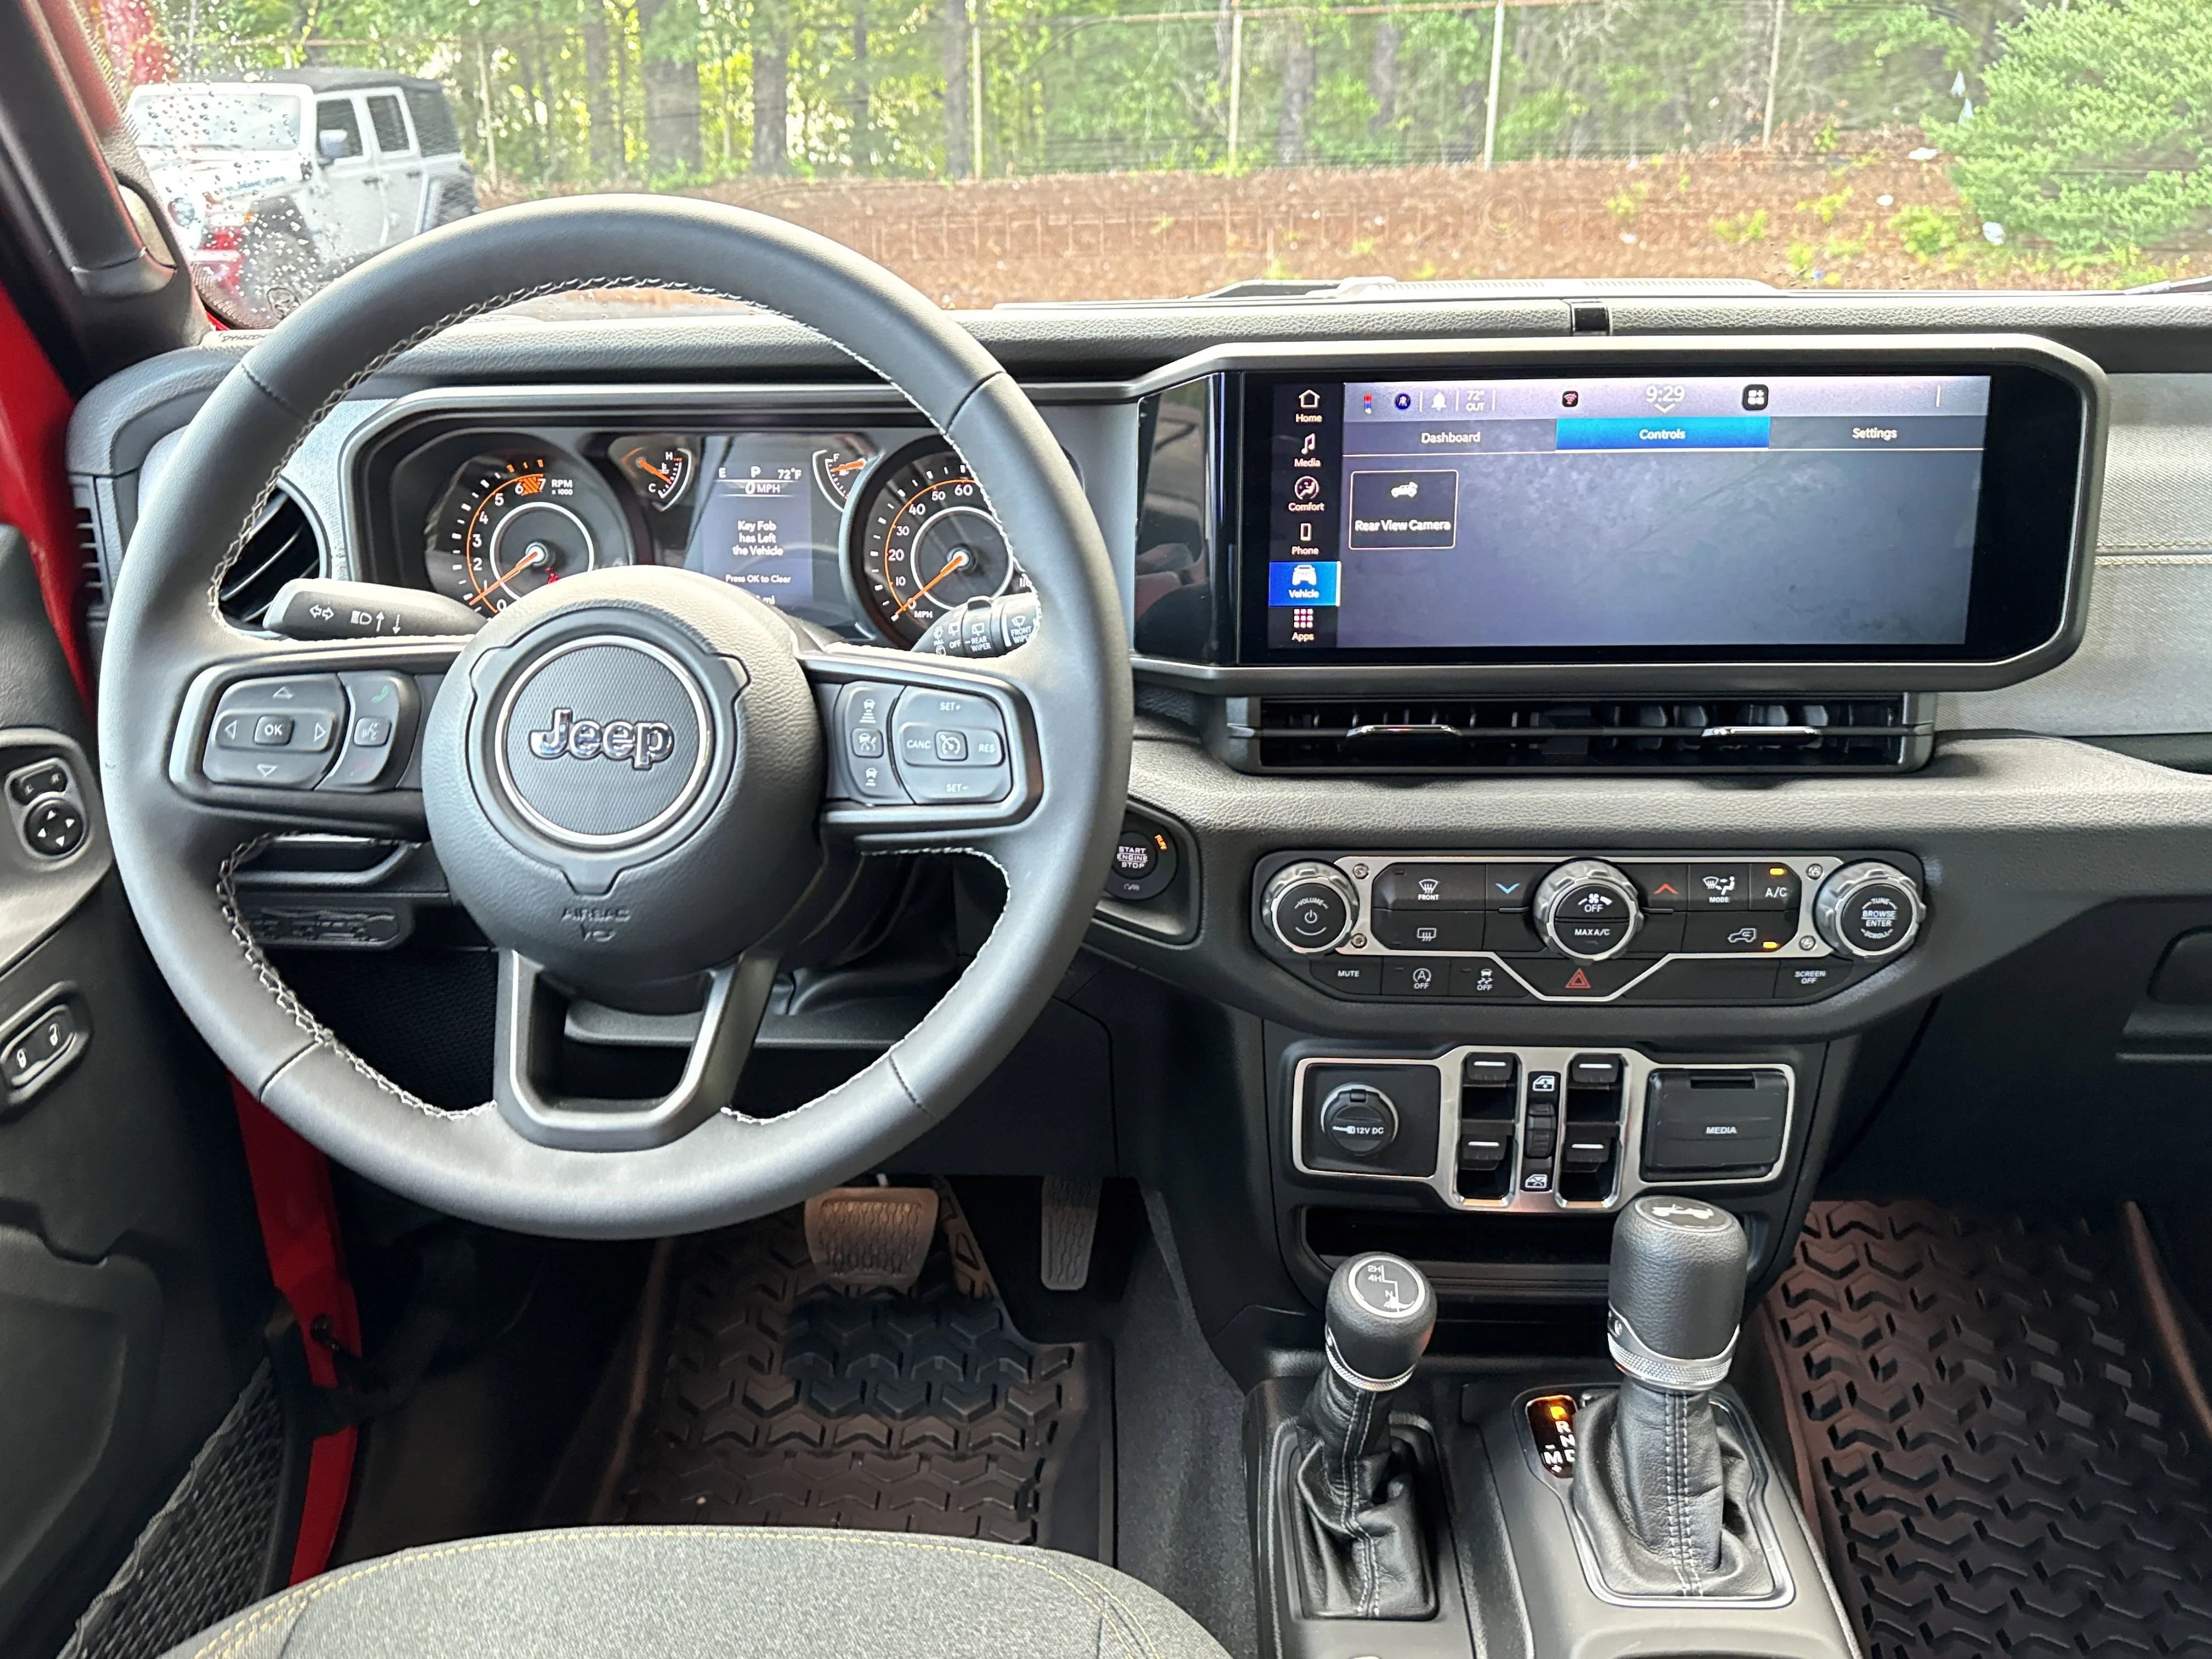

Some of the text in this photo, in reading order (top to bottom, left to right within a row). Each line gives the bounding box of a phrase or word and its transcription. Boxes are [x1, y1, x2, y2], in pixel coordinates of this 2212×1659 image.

[1646, 386, 1684, 402] 9:29
[1465, 403, 1485, 411] OUT
[1295, 413, 1323, 423] Home
[1421, 431, 1481, 444] Dashboard
[1639, 427, 1686, 441] Controls
[1852, 426, 1898, 441] Settings
[665, 452, 673, 460] H
[833, 453, 840, 462] F
[1294, 458, 1321, 468] Media
[718, 467, 726, 478] E
[751, 466, 761, 478] P
[515, 483, 524, 494] 6
[539, 478, 546, 490] 7
[551, 479, 573, 488] RPM
[648, 483, 656, 492] C
[745, 482, 780, 494] 0 MPH
[954, 484, 973, 496] 60
[495, 493, 504, 506] 5
[932, 491, 946, 501] 50
[909, 503, 926, 516] 40
[1288, 502, 1324, 512] Comfort
[479, 511, 489, 524] 4
[737, 520, 777, 532] Key Fob
[1355, 520, 1451, 531] Rear View Camera
[896, 526, 910, 536] 30
[472, 534, 482, 548] 3
[739, 533, 776, 543] has Left
[732, 545, 783, 556] the Vehicle
[888, 549, 905, 561] 20
[1291, 546, 1319, 555] Phone
[473, 557, 482, 571] 2
[725, 574, 792, 583] Press OK to Clear
[895, 576, 906, 586] 10
[1288, 589, 1319, 599] Vehicle
[913, 610, 933, 619] MPH
[1011, 625, 1031, 637] FRONT
[971, 635, 988, 644] REAR
[1291, 632, 1314, 642] Apps
[949, 639, 961, 648] OFF
[970, 642, 991, 652] WIPER
[264, 723, 283, 736] OK
[529, 707, 675, 770] Jeep
[906, 739, 931, 749] CANC
[978, 743, 995, 753] RES
[1154, 834, 1167, 850] RUN
[1116, 854, 1148, 862] ENGINE
[1765, 887, 1787, 899] A/C
[1297, 898, 1324, 906] VOLUME
[1584, 904, 1603, 913] OFF
[1356, 1126, 1370, 1135] 12V
[1706, 1126, 1737, 1135] MEDIA
[1368, 1274, 1382, 1283] 4H
[1555, 1420, 1572, 1434] R
[1559, 1434, 1576, 1448] N
[1543, 1450, 1564, 1465] M
